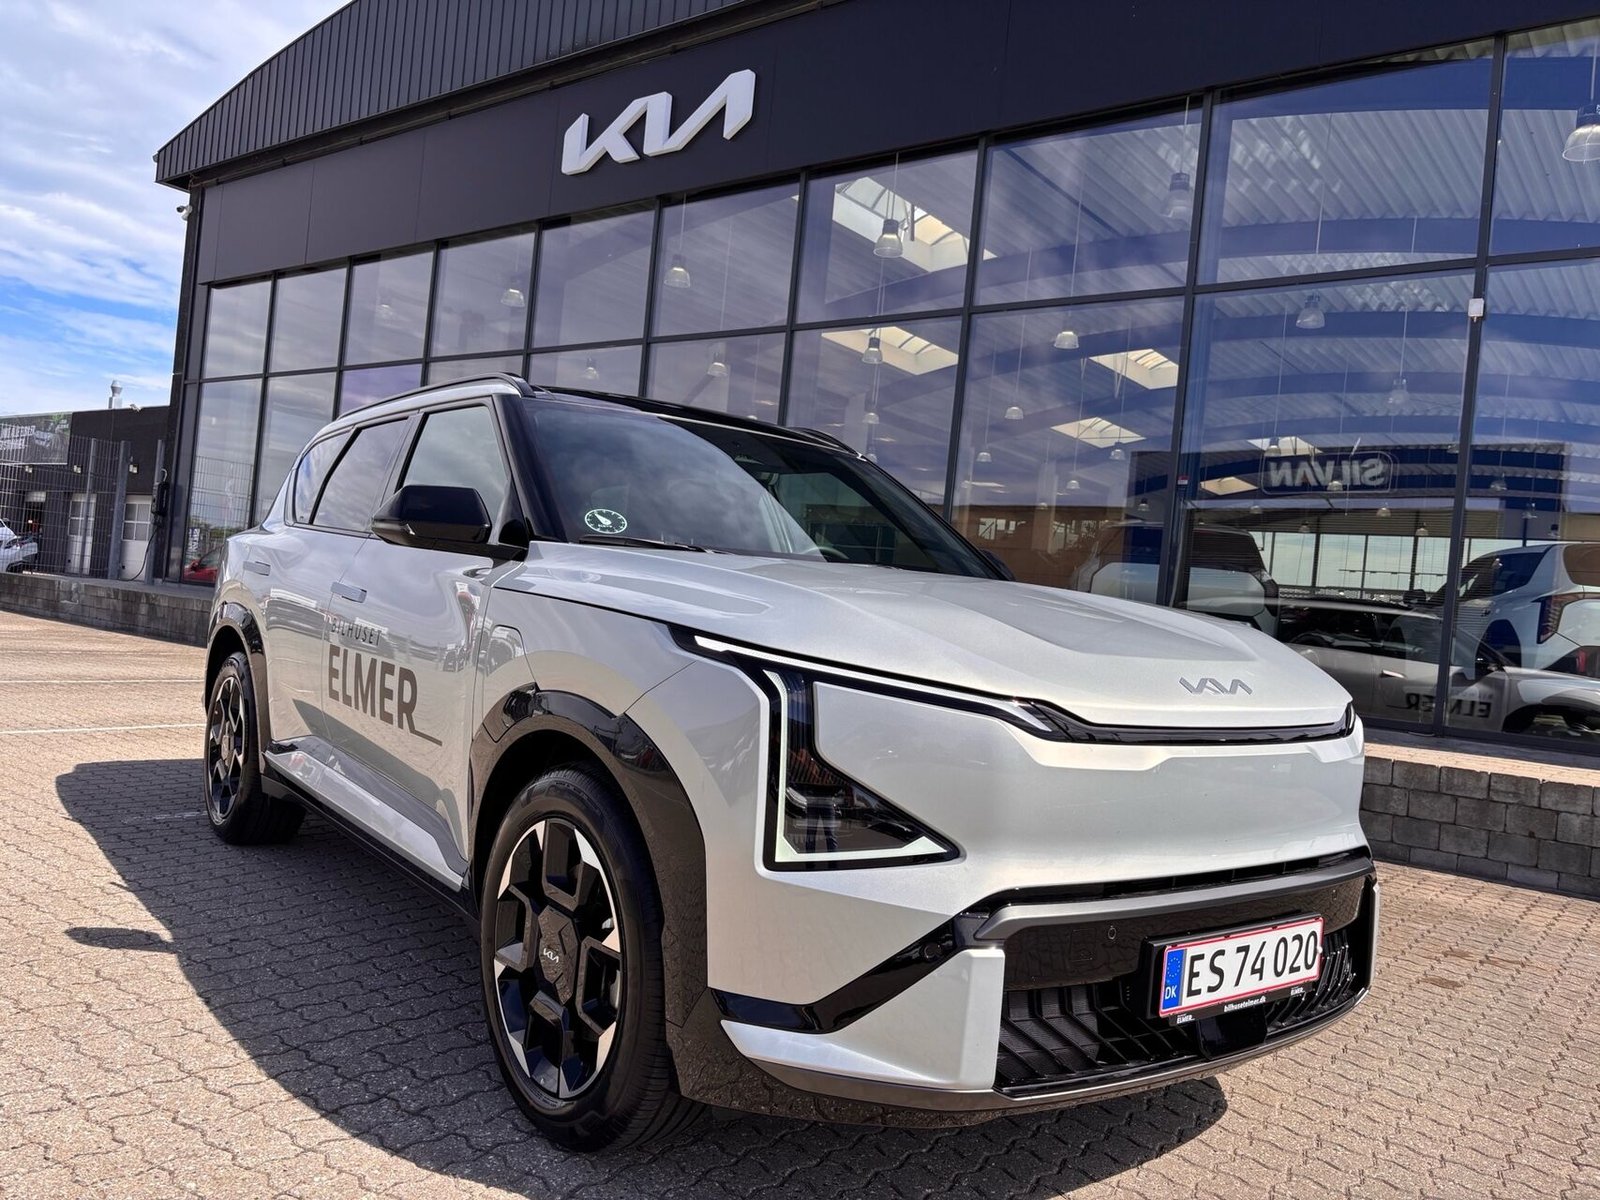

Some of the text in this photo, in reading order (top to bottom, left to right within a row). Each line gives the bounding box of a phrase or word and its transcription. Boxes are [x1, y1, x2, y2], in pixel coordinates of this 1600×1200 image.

[562, 69, 756, 175] KIA
[331, 617, 382, 646] BILHUSET
[329, 644, 442, 746] ELMER
[1179, 677, 1253, 696] KIA
[1186, 930, 1318, 998] ES 74 020
[1165, 985, 1177, 1000] DK
